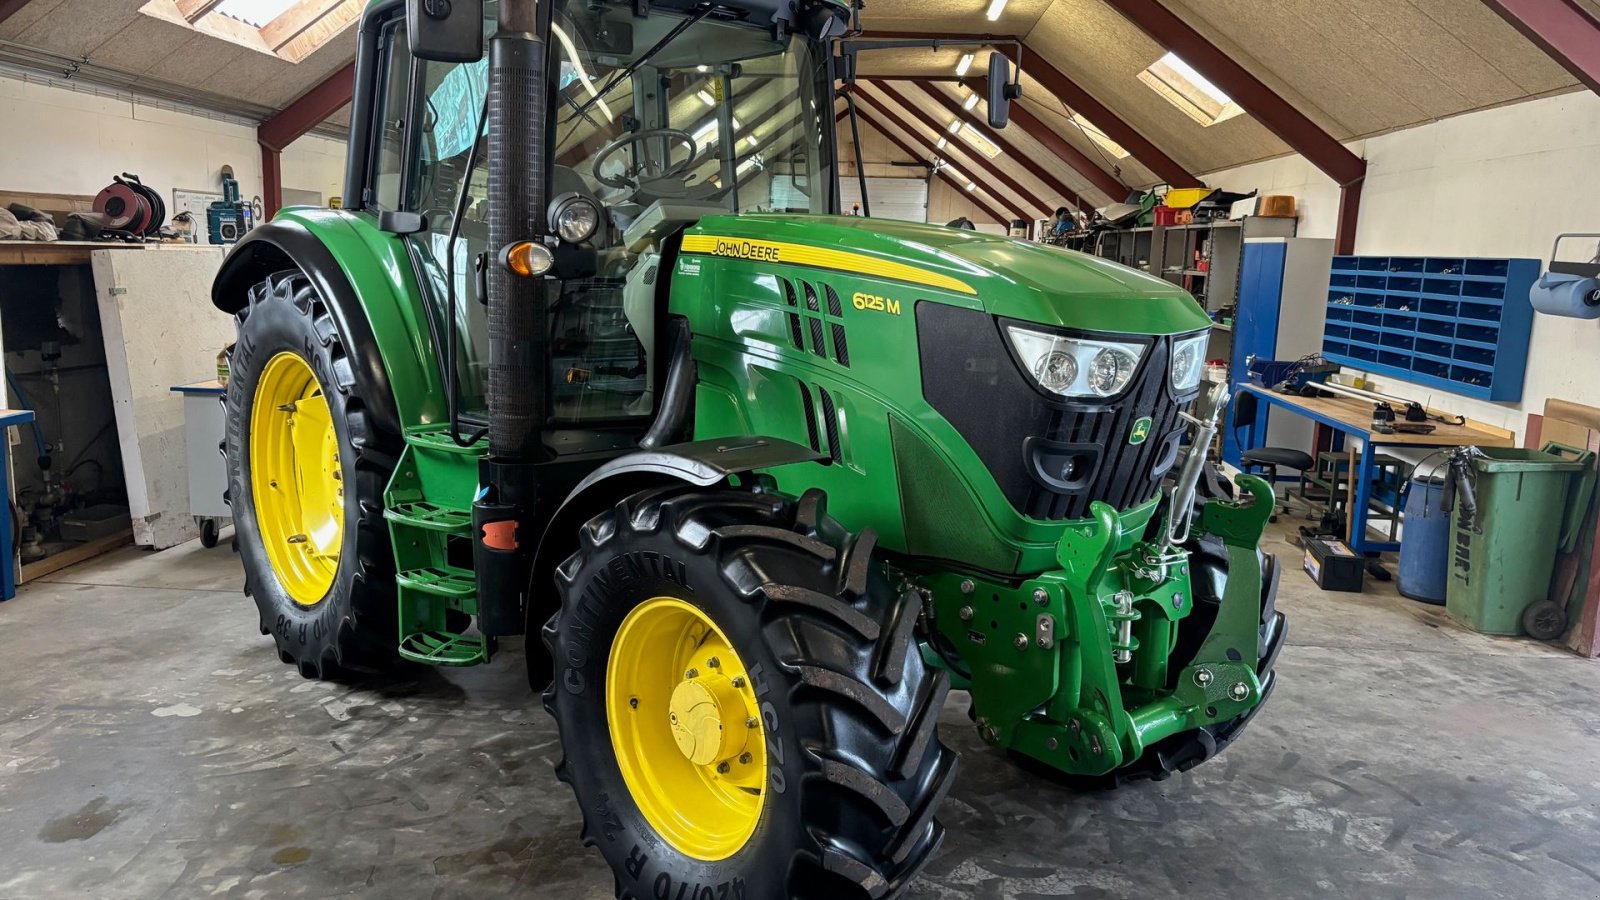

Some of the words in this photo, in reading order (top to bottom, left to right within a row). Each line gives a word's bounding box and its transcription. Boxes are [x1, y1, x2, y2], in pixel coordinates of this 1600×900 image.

[712, 238, 741, 257] JOHN
[741, 241, 780, 262] DEERE
[852, 291, 885, 312] 6125
[886, 297, 901, 316] M
[563, 550, 695, 696] CONTINENTAL
[748, 662, 787, 794] HC70
[624, 843, 649, 882] R
